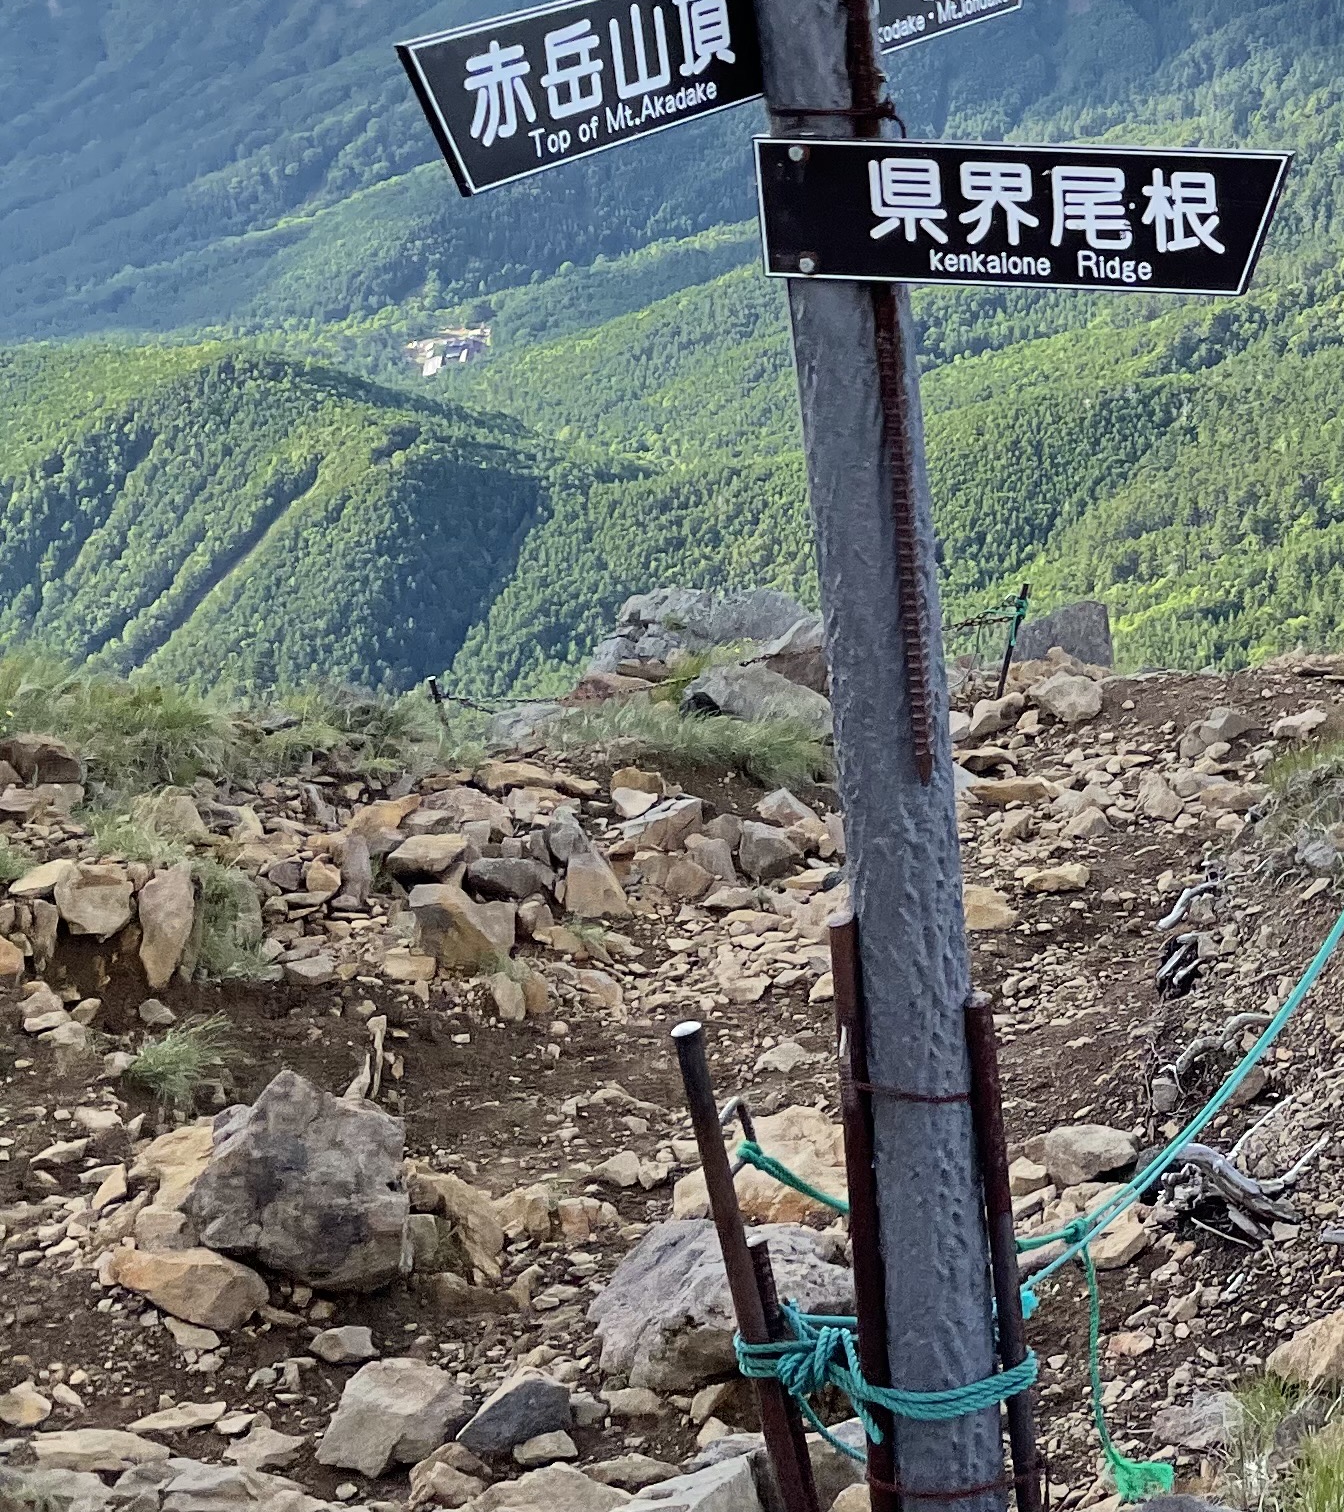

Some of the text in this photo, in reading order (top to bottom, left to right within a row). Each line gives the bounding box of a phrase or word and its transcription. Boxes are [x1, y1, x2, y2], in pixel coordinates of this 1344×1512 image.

[528, 82, 718, 158] Top of Mt.Akadake
[868, 158, 1226, 255] 県界尾根
[1078, 249, 1153, 283] Ridge
